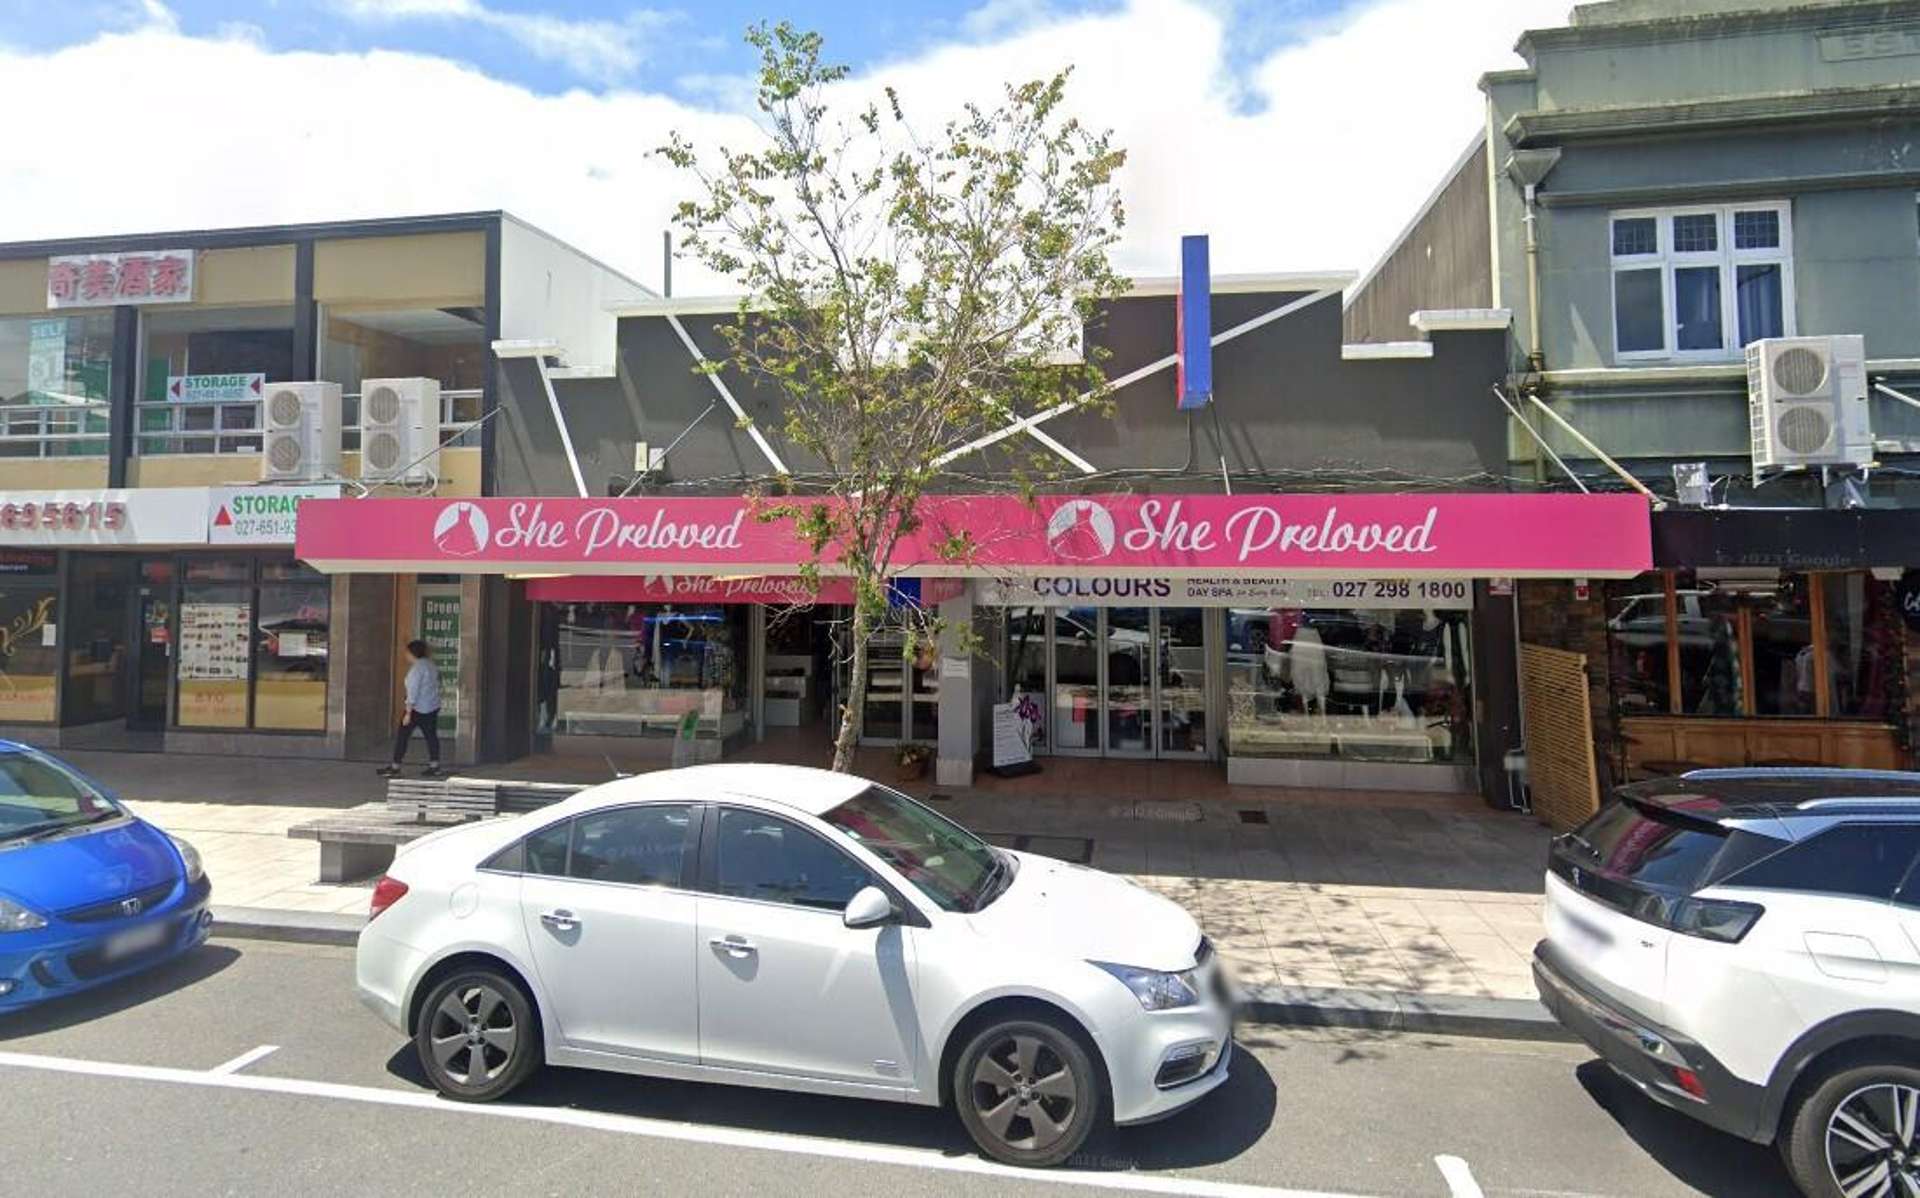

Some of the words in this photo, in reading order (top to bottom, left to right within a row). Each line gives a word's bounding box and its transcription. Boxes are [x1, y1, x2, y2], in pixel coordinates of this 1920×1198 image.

[185, 376, 247, 388] STORAGE
[233, 495, 314, 514] STORA
[495, 501, 568, 547] She
[575, 507, 745, 557] Preloved
[1124, 500, 1216, 550] She
[1226, 506, 1437, 561] Preloved
[677, 576, 716, 594] She
[1034, 577, 1171, 597] COLOURS
[1187, 587, 1209, 597] DAY
[1211, 587, 1233, 597] SPA
[1333, 582, 1367, 598] 027
[1374, 581, 1410, 598] 298
[1418, 581, 1466, 599] 1800
